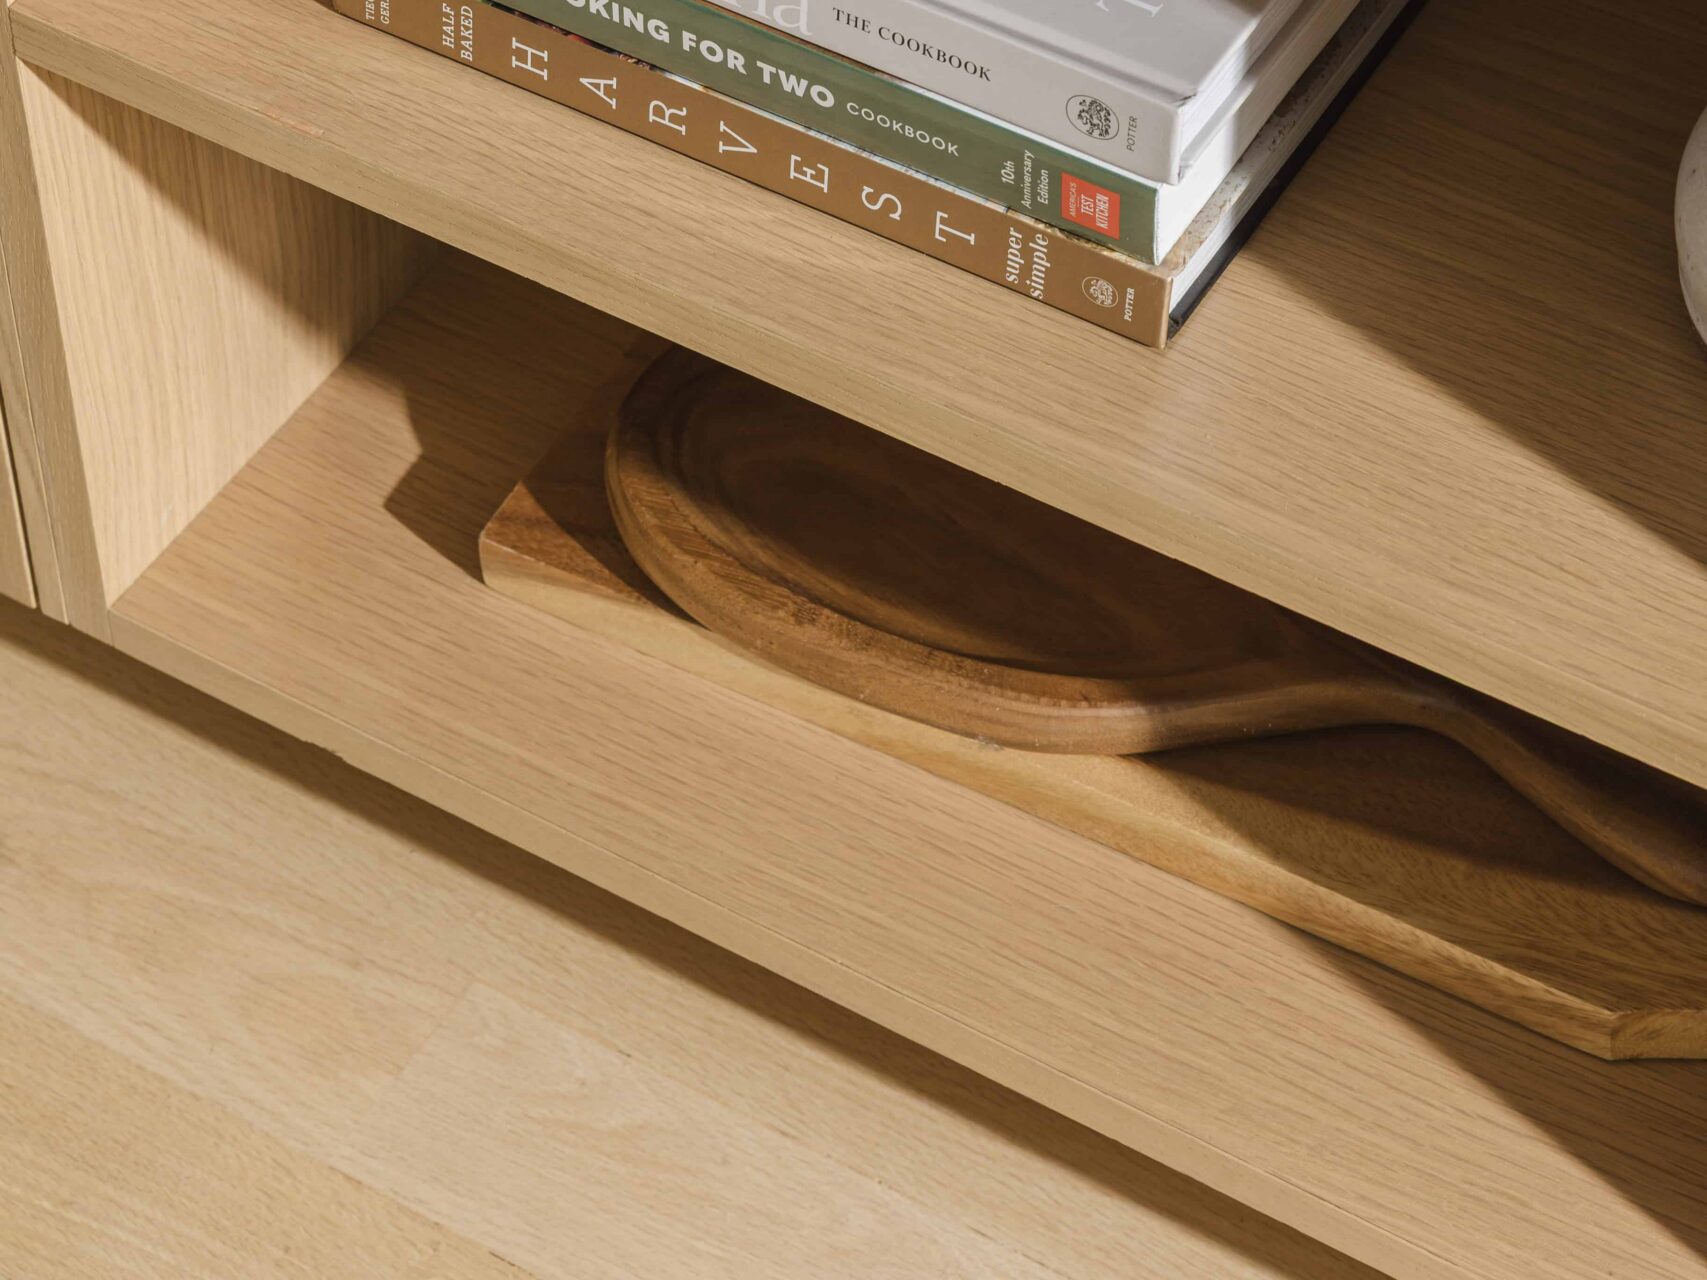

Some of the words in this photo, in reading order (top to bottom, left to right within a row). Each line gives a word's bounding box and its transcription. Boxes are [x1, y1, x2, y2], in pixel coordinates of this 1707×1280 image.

[443, 3, 455, 48] HALF
[460, 5, 473, 61] BAKED
[832, 7, 871, 34] THE
[878, 27, 992, 81] COOKBOOK
[682, 32, 748, 75] FOR
[756, 60, 835, 108] TWO
[846, 102, 960, 156] COOKBOOK
[1126, 116, 1137, 152] POTTER
[1001, 160, 1015, 184] 10th
[1020, 149, 1035, 209] Anniversary
[1037, 170, 1049, 205] Edition
[1080, 194, 1094, 216] TEST
[1095, 193, 1110, 230] KITCHEN
[1005, 227, 1025, 284] super
[1026, 233, 1049, 300] simple
[1123, 288, 1135, 322] POTTER
